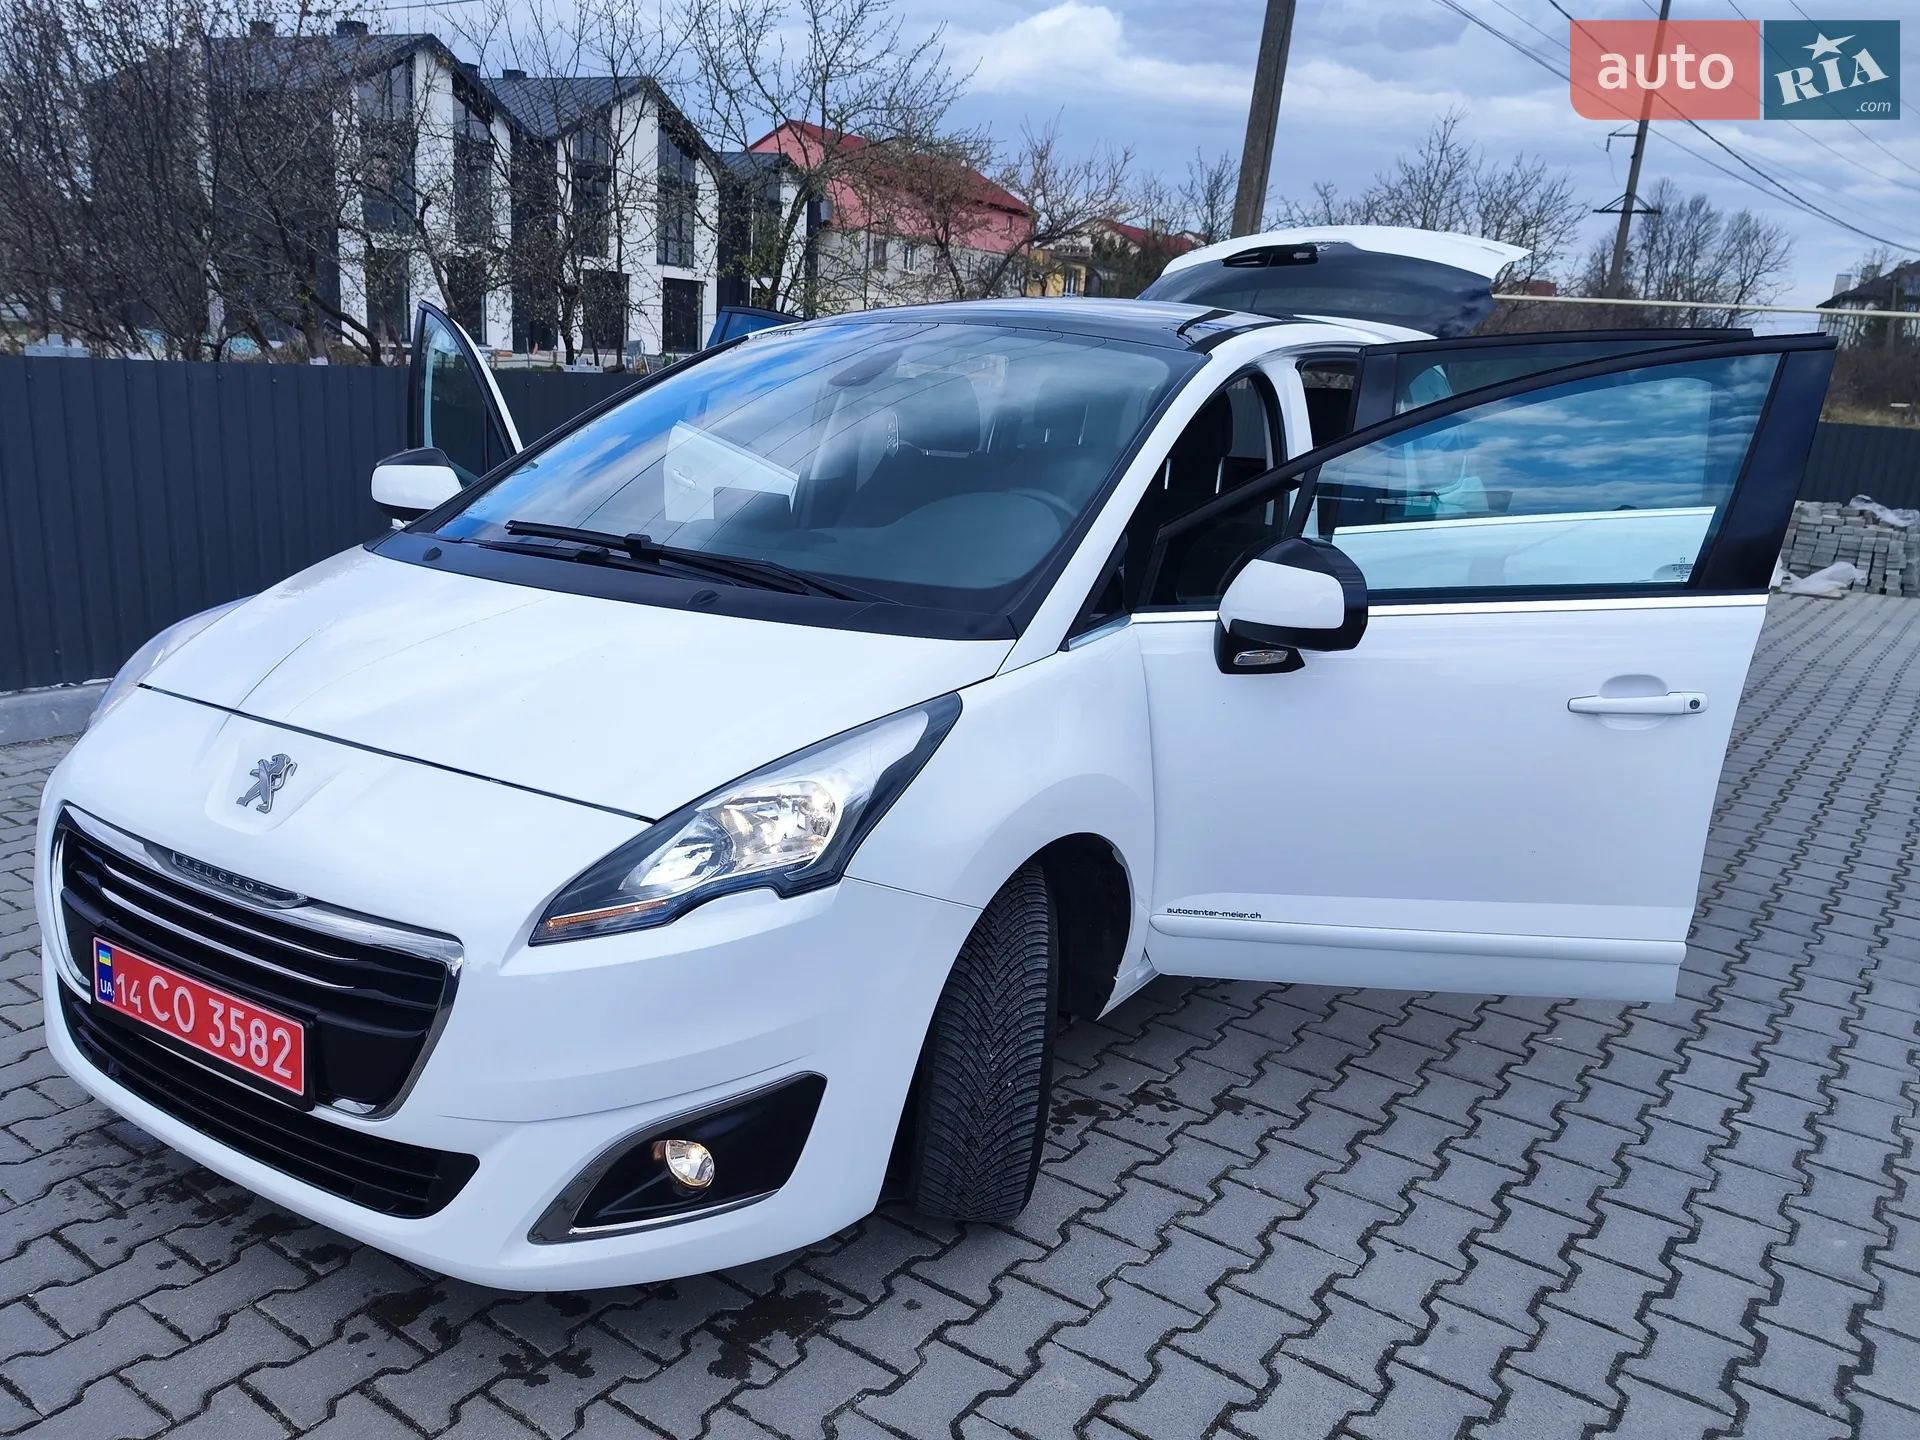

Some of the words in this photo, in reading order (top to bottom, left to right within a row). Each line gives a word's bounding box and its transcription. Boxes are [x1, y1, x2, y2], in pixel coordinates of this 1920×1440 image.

[180, 856, 269, 893] PEUGEOT
[1166, 907, 1262, 919] autocenter-meier.ch
[100, 978, 113, 996] UA
[208, 997, 293, 1080] 3582
